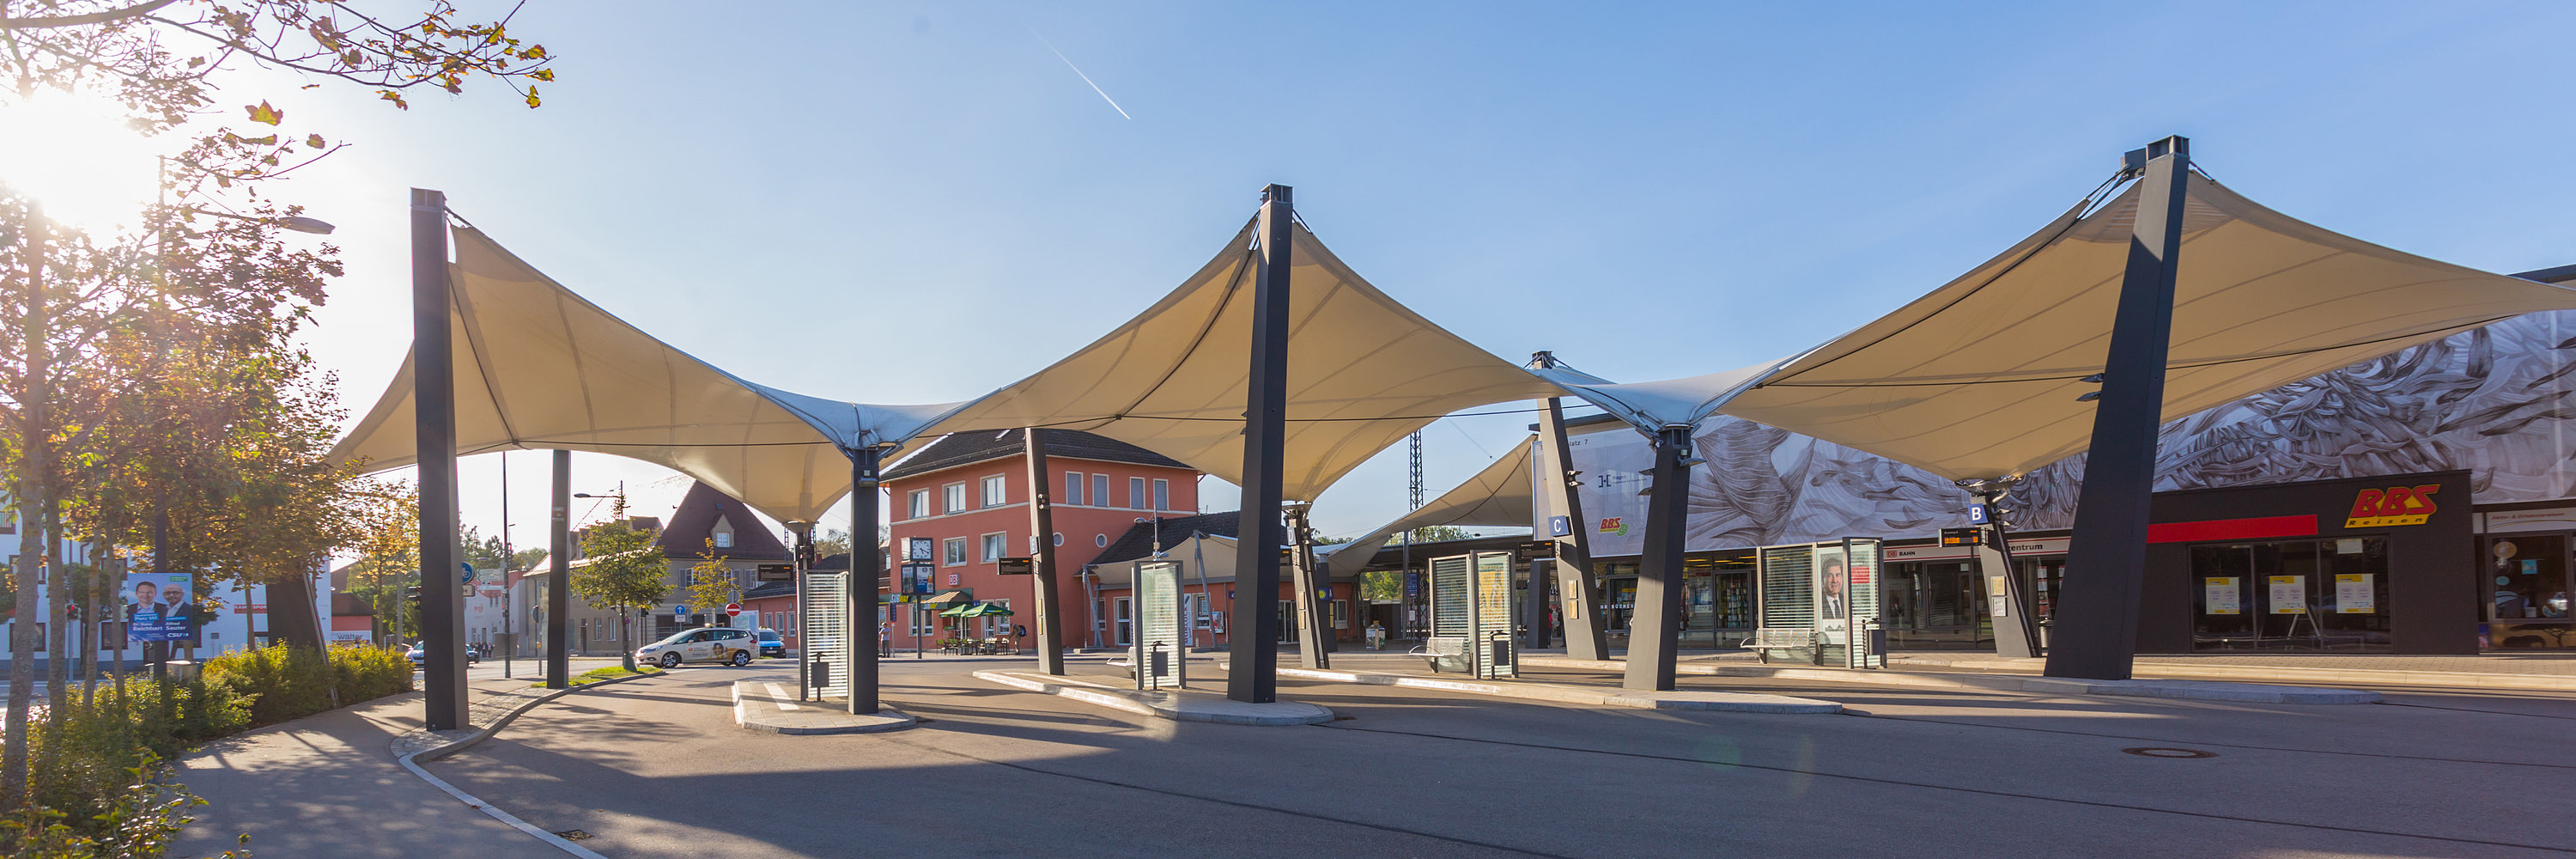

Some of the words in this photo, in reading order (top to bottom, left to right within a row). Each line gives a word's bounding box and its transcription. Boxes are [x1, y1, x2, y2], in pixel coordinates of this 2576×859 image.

[2351, 484, 2440, 518] BBS
[1971, 507, 1982, 521] B
[1553, 519, 1562, 533] C
[1601, 517, 1622, 530] BBS
[2348, 517, 2423, 526] Reisen
[949, 575, 958, 584] DB
